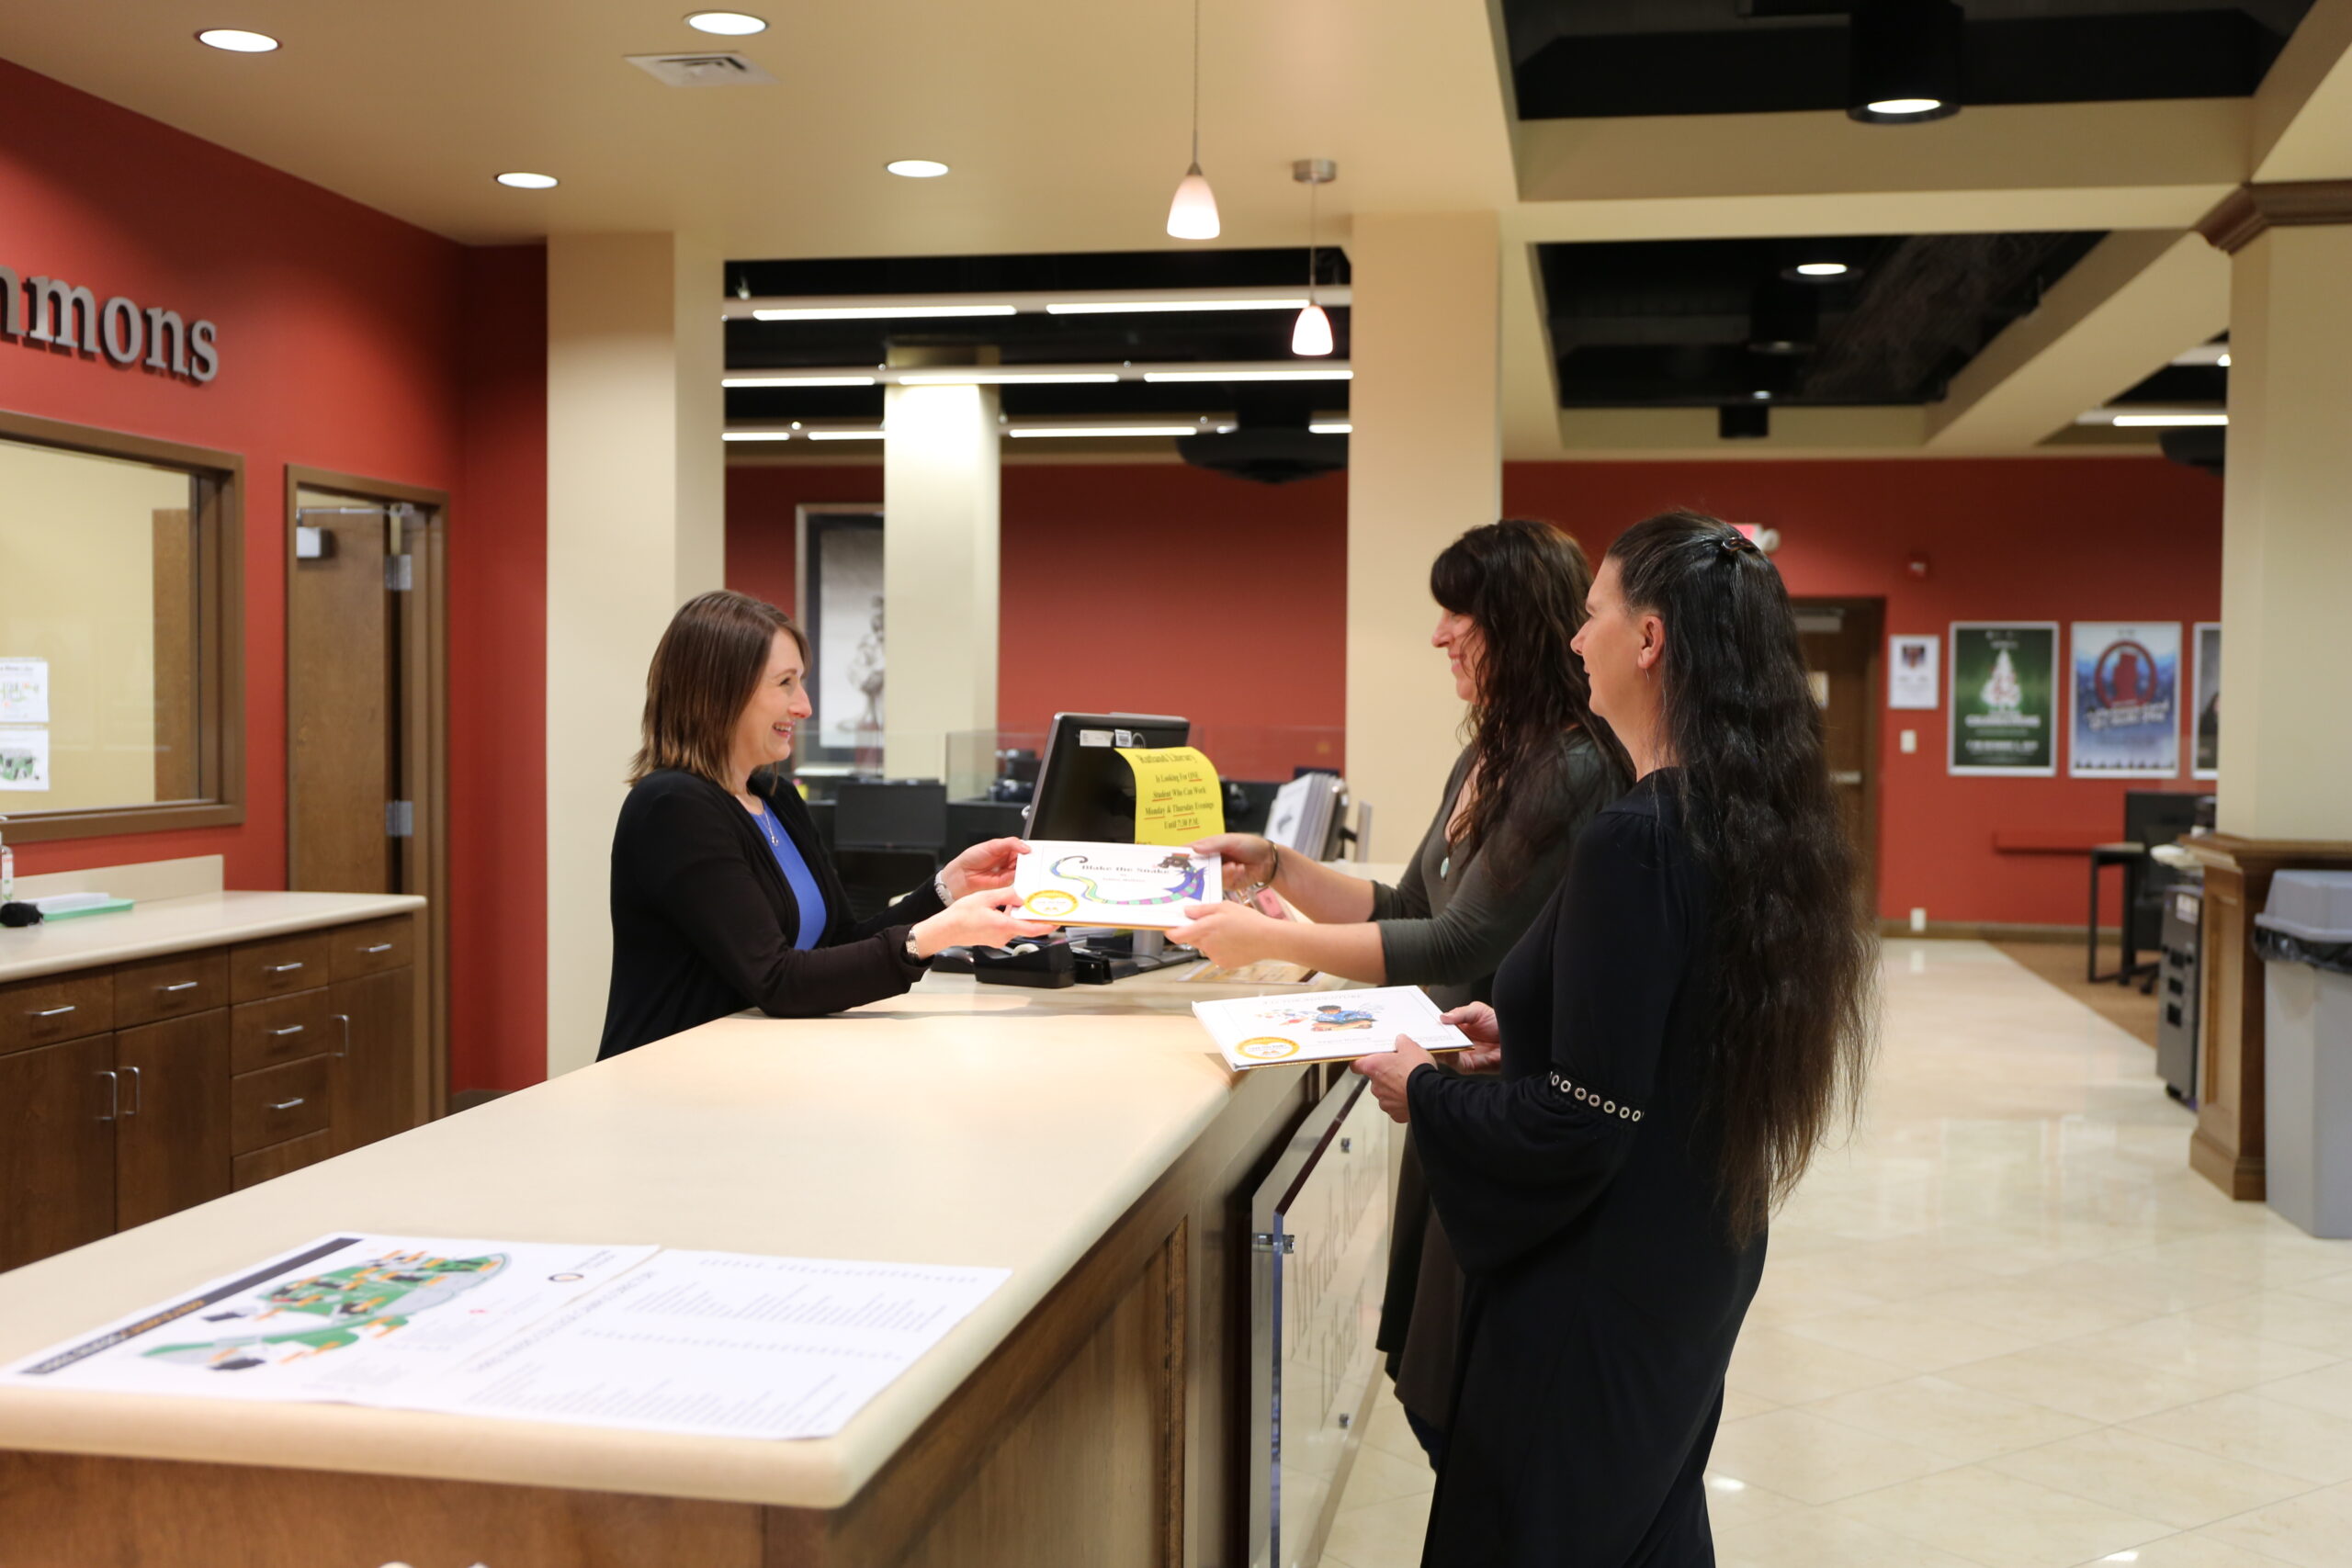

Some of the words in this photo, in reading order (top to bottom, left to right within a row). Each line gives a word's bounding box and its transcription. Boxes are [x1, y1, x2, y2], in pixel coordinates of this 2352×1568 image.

[1160, 773, 1180, 784] Looking
[1153, 789, 1171, 798] Student
[1171, 789, 1182, 797] Who
[1193, 786, 1206, 795] Work
[1145, 806, 1165, 817] Monday
[1172, 804, 1194, 813] Thursday
[1194, 801, 1215, 810] Evenings
